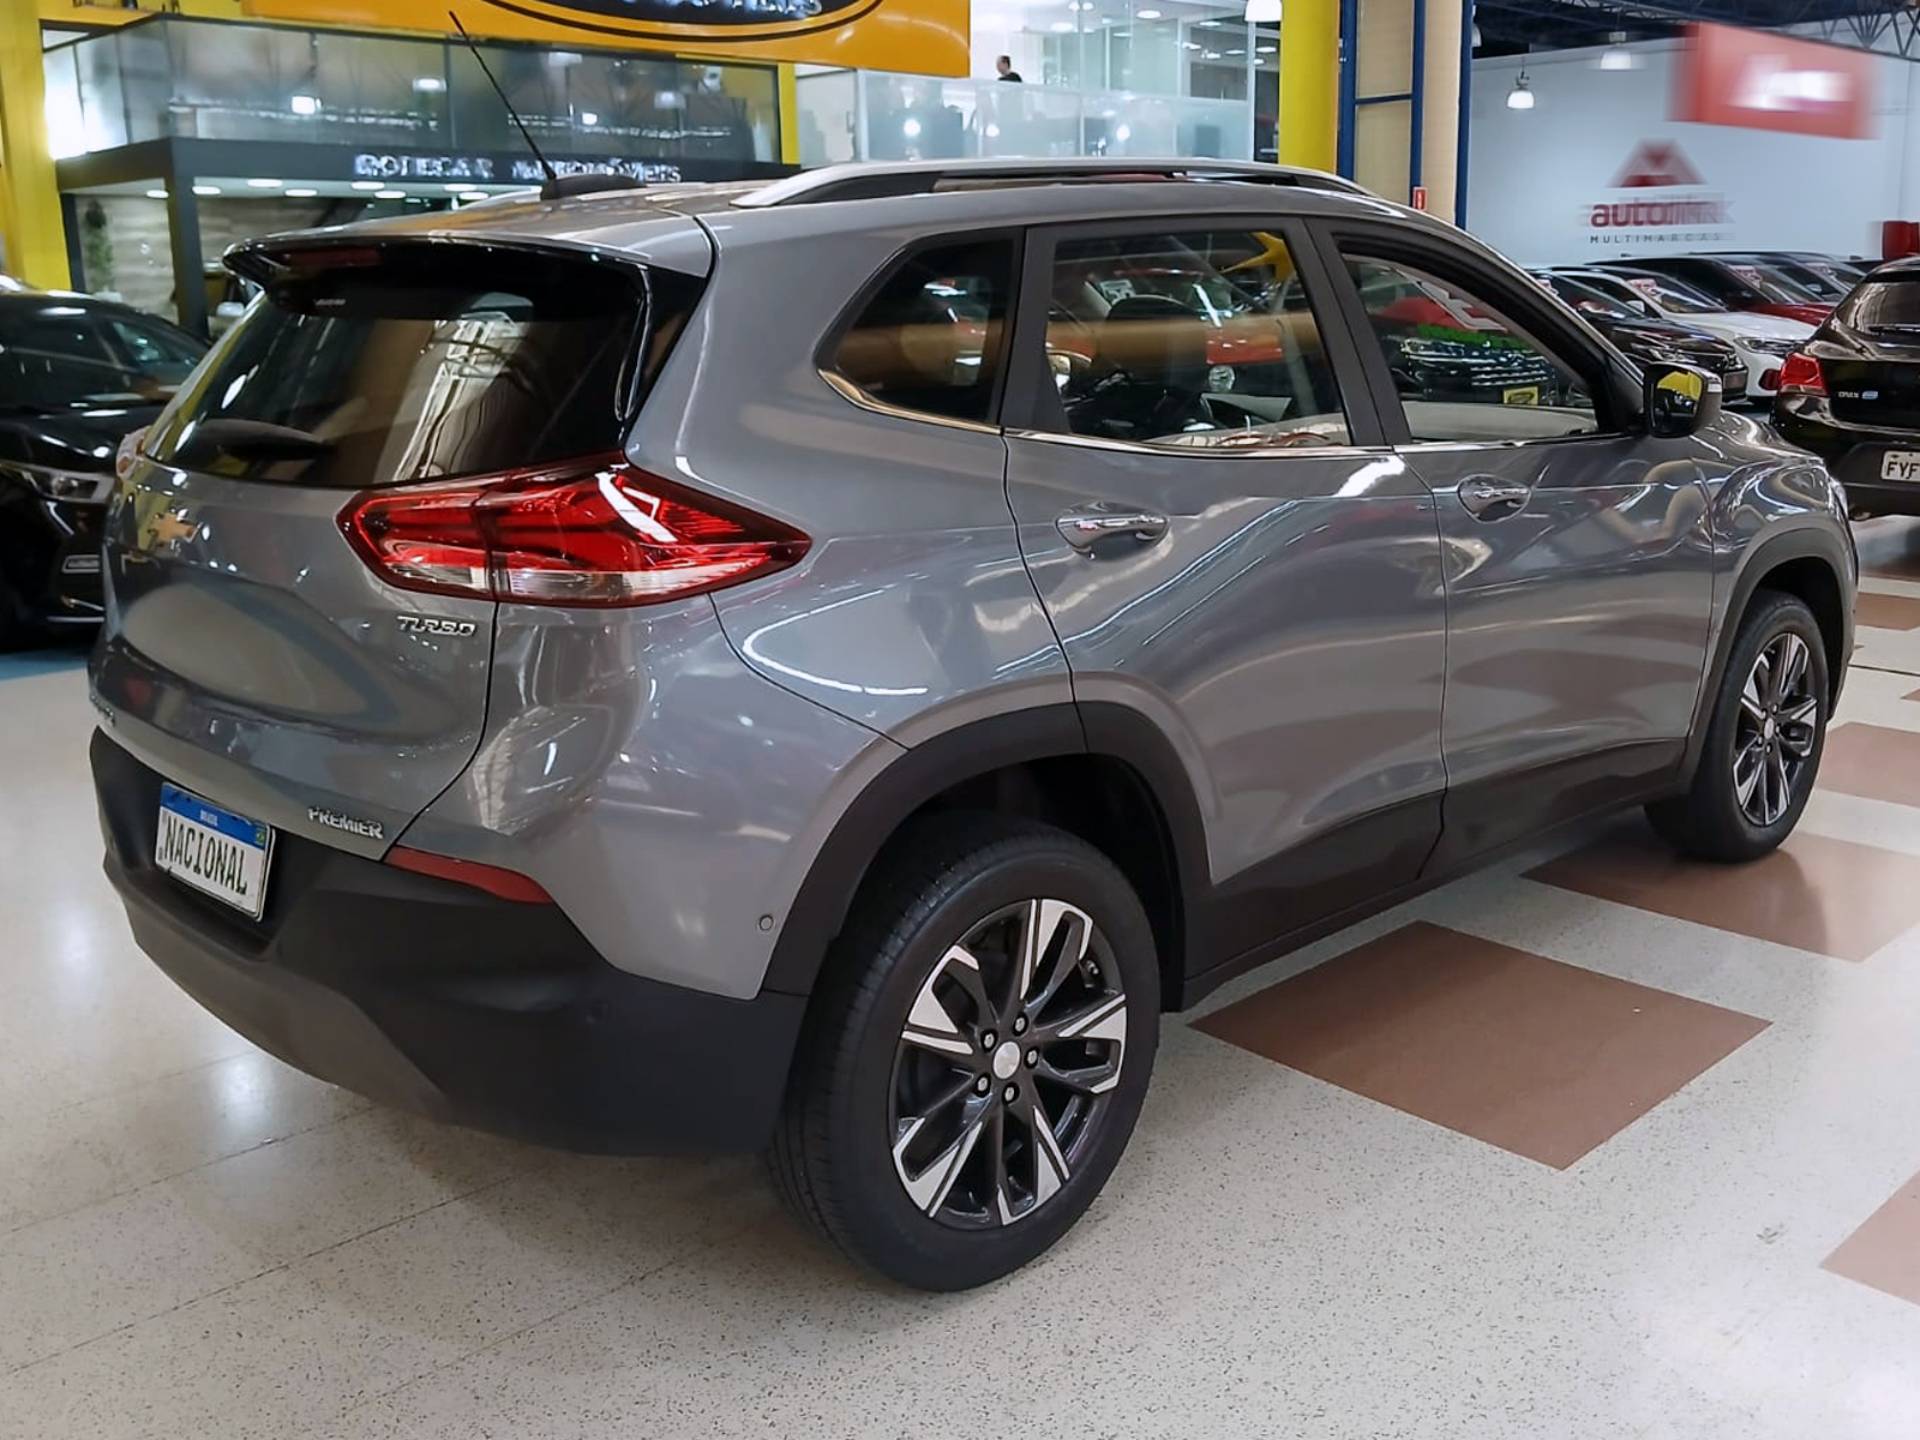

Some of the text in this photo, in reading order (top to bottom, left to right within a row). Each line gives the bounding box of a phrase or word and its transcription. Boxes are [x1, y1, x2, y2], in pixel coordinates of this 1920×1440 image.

[1590, 234, 1721, 244] MULTIMARCAS
[308, 806, 384, 840] PREMIER
[165, 815, 248, 895] NACIONAL
